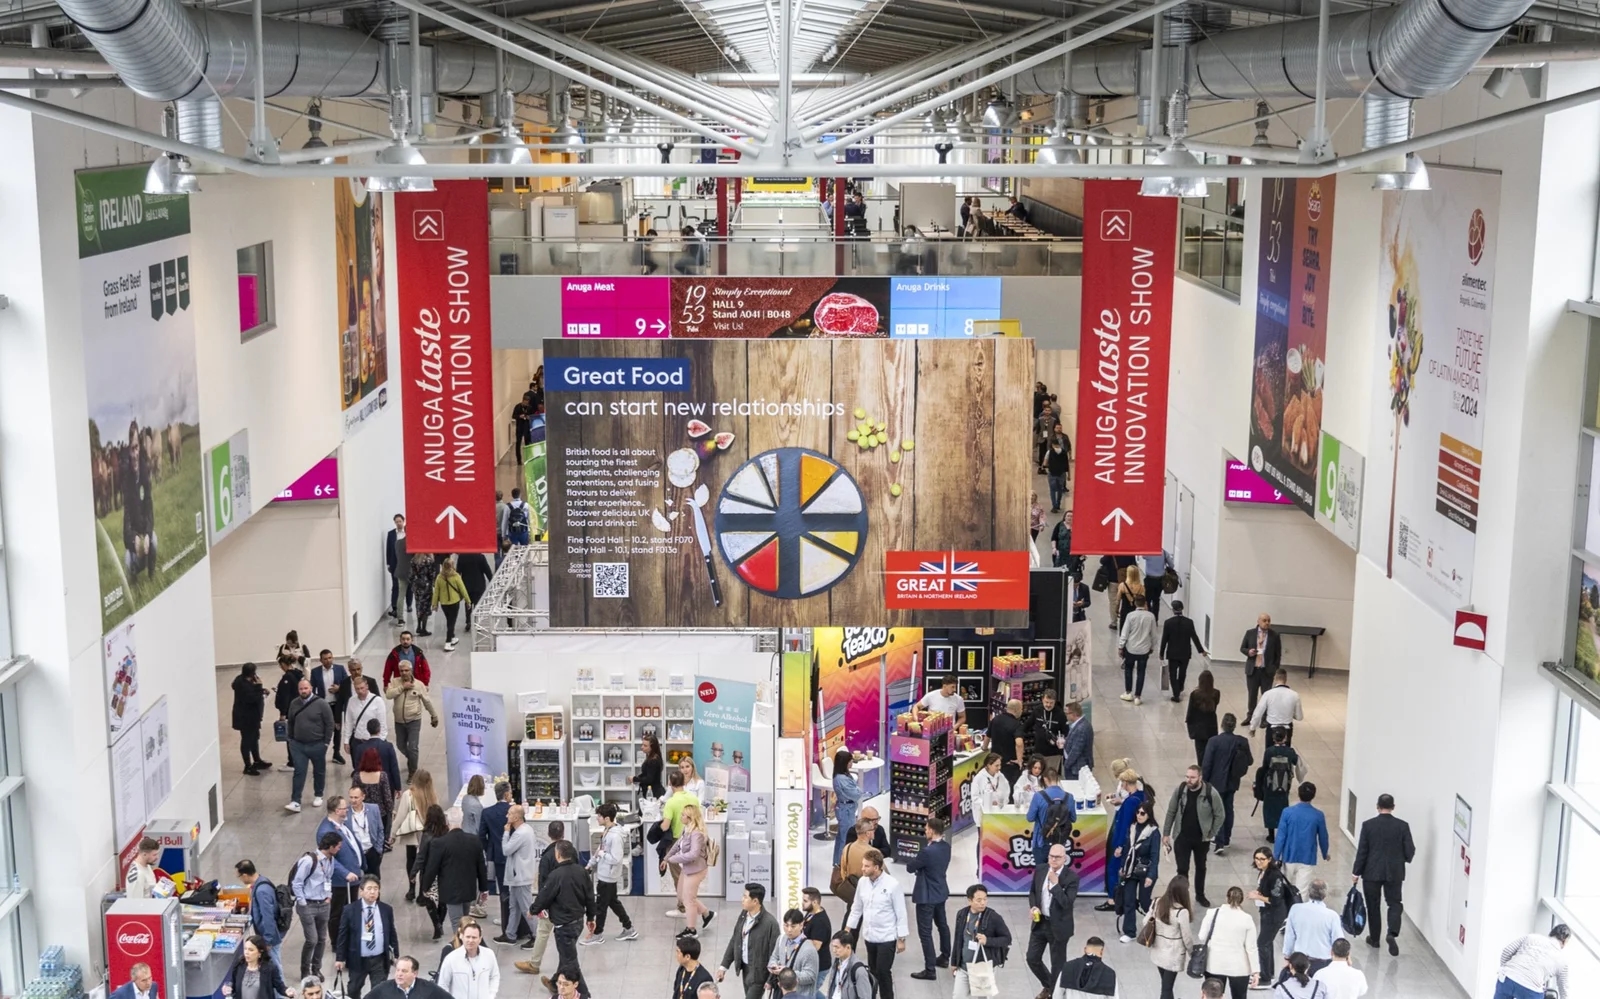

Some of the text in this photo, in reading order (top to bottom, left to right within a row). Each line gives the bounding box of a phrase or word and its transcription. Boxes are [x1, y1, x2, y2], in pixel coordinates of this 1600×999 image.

[100, 194, 143, 231] IRELAND
[1266, 220, 1282, 263] 53
[103, 277, 119, 298] Grass
[120, 274, 130, 292] Fed
[130, 270, 142, 290] Beef
[566, 282, 614, 293] Anuga Meat
[896, 282, 950, 292] Anuga Drinks
[684, 286, 706, 306] 19
[712, 288, 793, 298] Simply Exceptional
[104, 294, 138, 320] from Ireland
[712, 300, 744, 309] HALL 9
[678, 305, 706, 324] 53
[712, 310, 738, 319] Stand
[740, 310, 760, 319] A041
[767, 310, 790, 319] B048
[635, 318, 646, 336] 9
[713, 322, 744, 330] Visit Us!
[964, 318, 974, 336] 8
[1457, 327, 1474, 346] TASTE
[447, 246, 476, 482] INNOVATION SHOW
[1124, 246, 1154, 484] INNOVATION SHOW
[1455, 346, 1482, 374] FUTURE
[564, 366, 683, 386] Great Food
[1452, 369, 1480, 394] AMERICA
[412, 306, 446, 482] ANUGA taste
[1091, 307, 1122, 485] ANUGA taste
[564, 398, 845, 419] can start new relationships
[1460, 394, 1478, 418] 2024
[566, 448, 656, 456] British food is all about
[566, 459, 599, 467] sourcing
[566, 469, 660, 477] ingredients, challenging
[314, 485, 322, 496] 6
[566, 479, 616, 487] conventions,
[635, 479, 659, 487] fusing
[1325, 461, 1336, 518] 9
[220, 464, 231, 526] 6
[574, 499, 596, 507] richer
[598, 500, 645, 508] experience.
[568, 536, 584, 544] Fine
[586, 536, 606, 544] Food
[608, 536, 623, 544] Hall
[632, 536, 648, 545] 10.2,
[650, 536, 673, 544] stand
[674, 536, 694, 544] F070
[568, 547, 588, 555] Dairy
[896, 579, 946, 591] GREAT
[700, 689, 715, 697] NEU
[466, 705, 481, 713] Alle
[452, 711, 495, 724] guten Dinge
[698, 718, 750, 732] Voller Geschma
[720, 713, 748, 723] Alkohol
[458, 720, 490, 732] sind Dry.
[787, 802, 803, 850] Green
[164, 836, 183, 845] Bull
[786, 861, 802, 910] Farms
